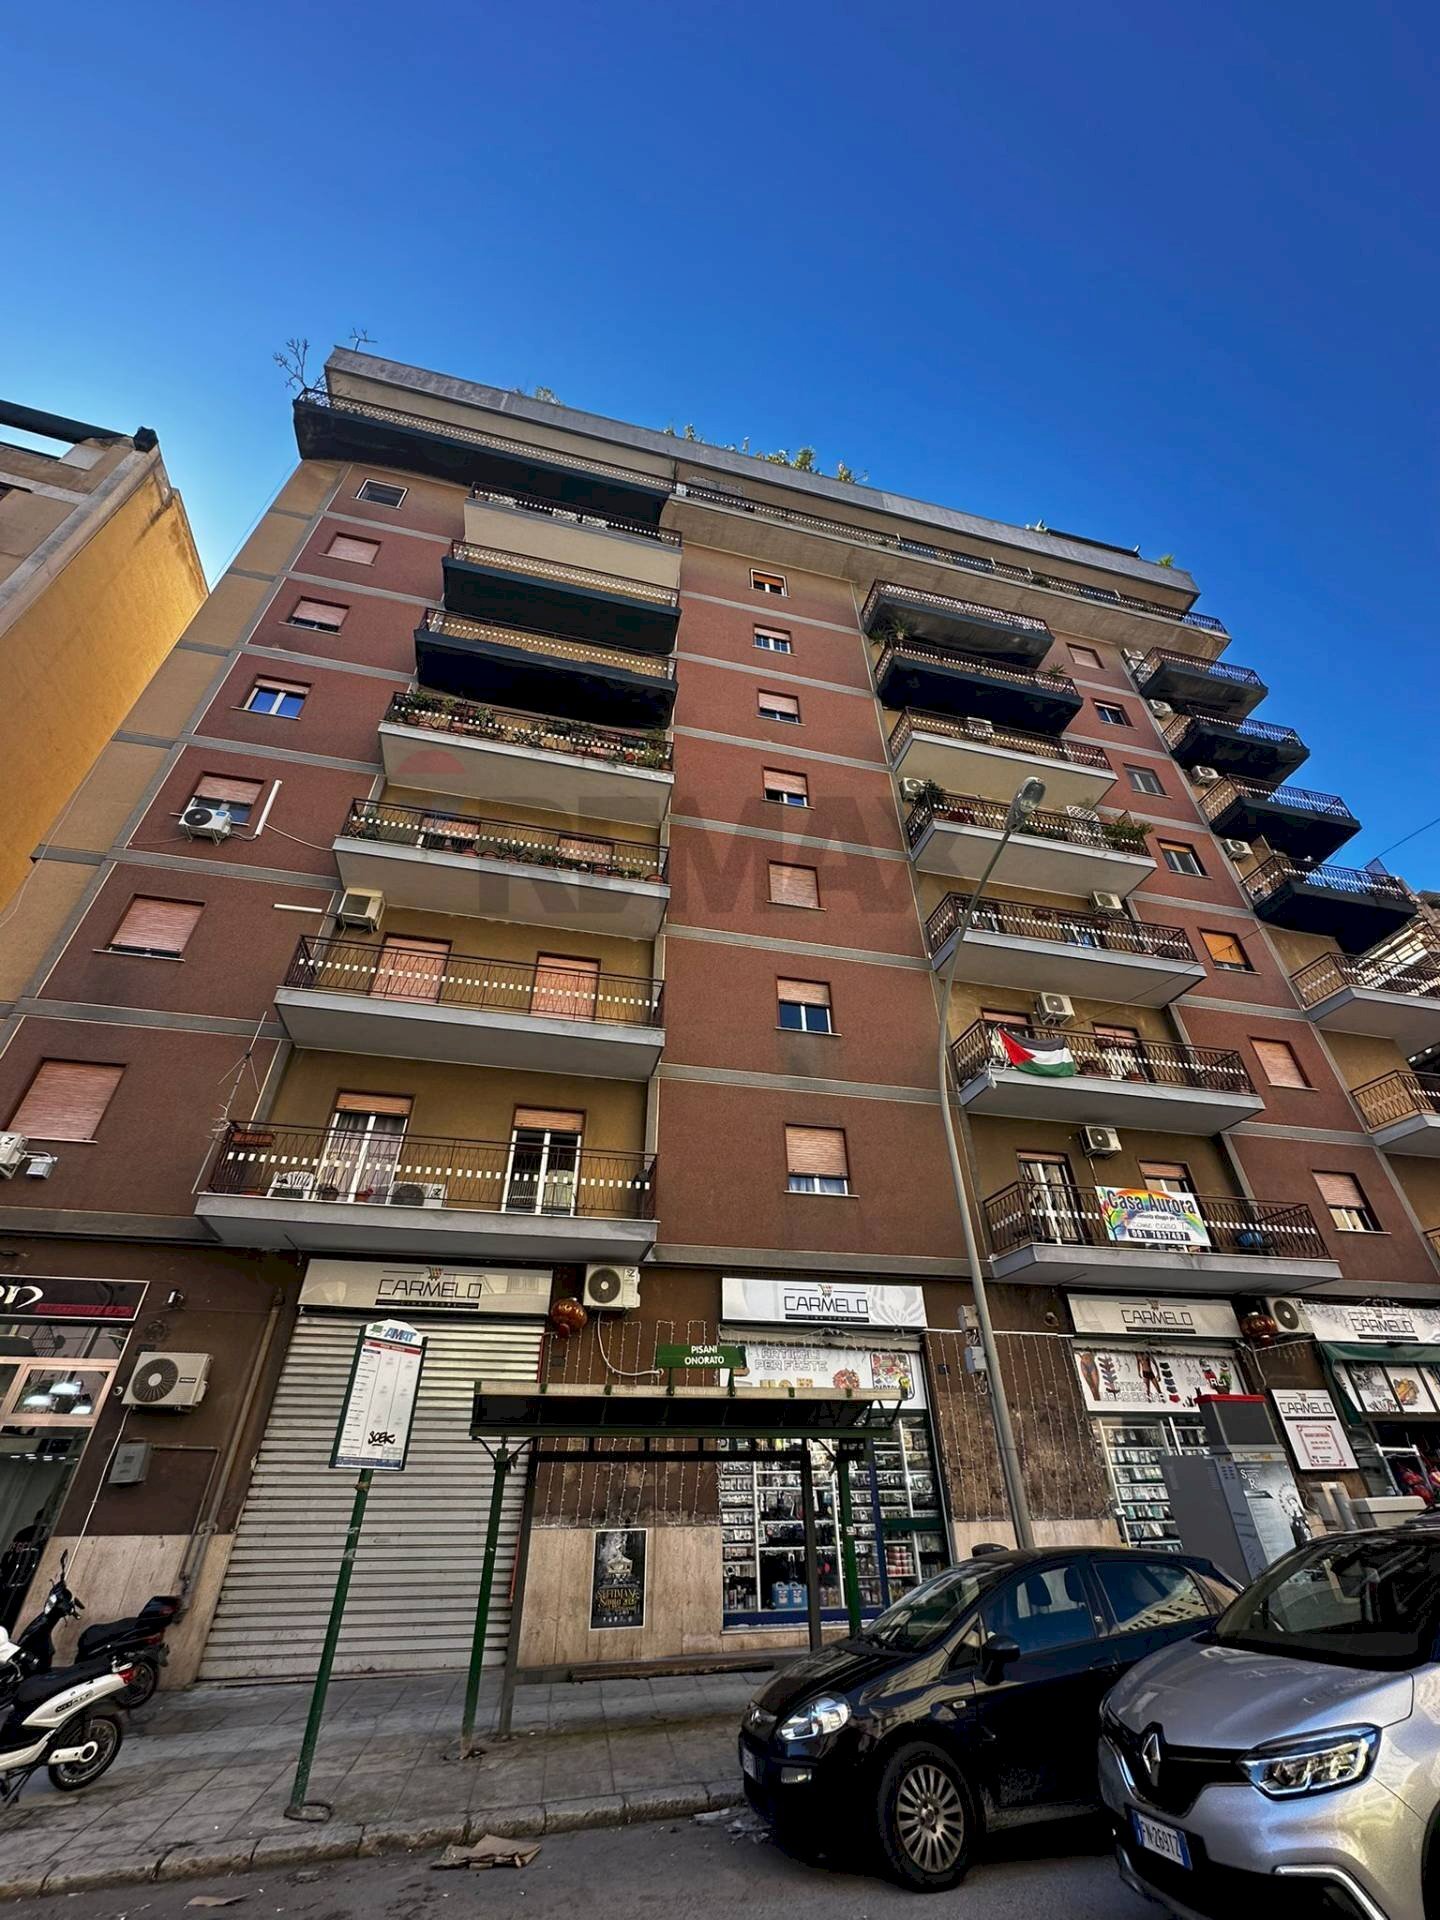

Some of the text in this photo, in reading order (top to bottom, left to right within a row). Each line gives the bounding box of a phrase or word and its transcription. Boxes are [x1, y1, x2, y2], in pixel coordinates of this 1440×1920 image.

[1107, 1189, 1197, 1214] Casa Aurora
[378, 1279, 482, 1299] CARMELO
[783, 1295, 869, 1314] CARMELO
[1120, 1309, 1194, 1326] CARMELO
[1350, 1318, 1416, 1333] CARMELO
[384, 1327, 418, 1343] AMAT
[691, 1345, 718, 1354] PISANI
[684, 1356, 725, 1366] ONORATO
[1279, 1402, 1334, 1414] CARMELO
